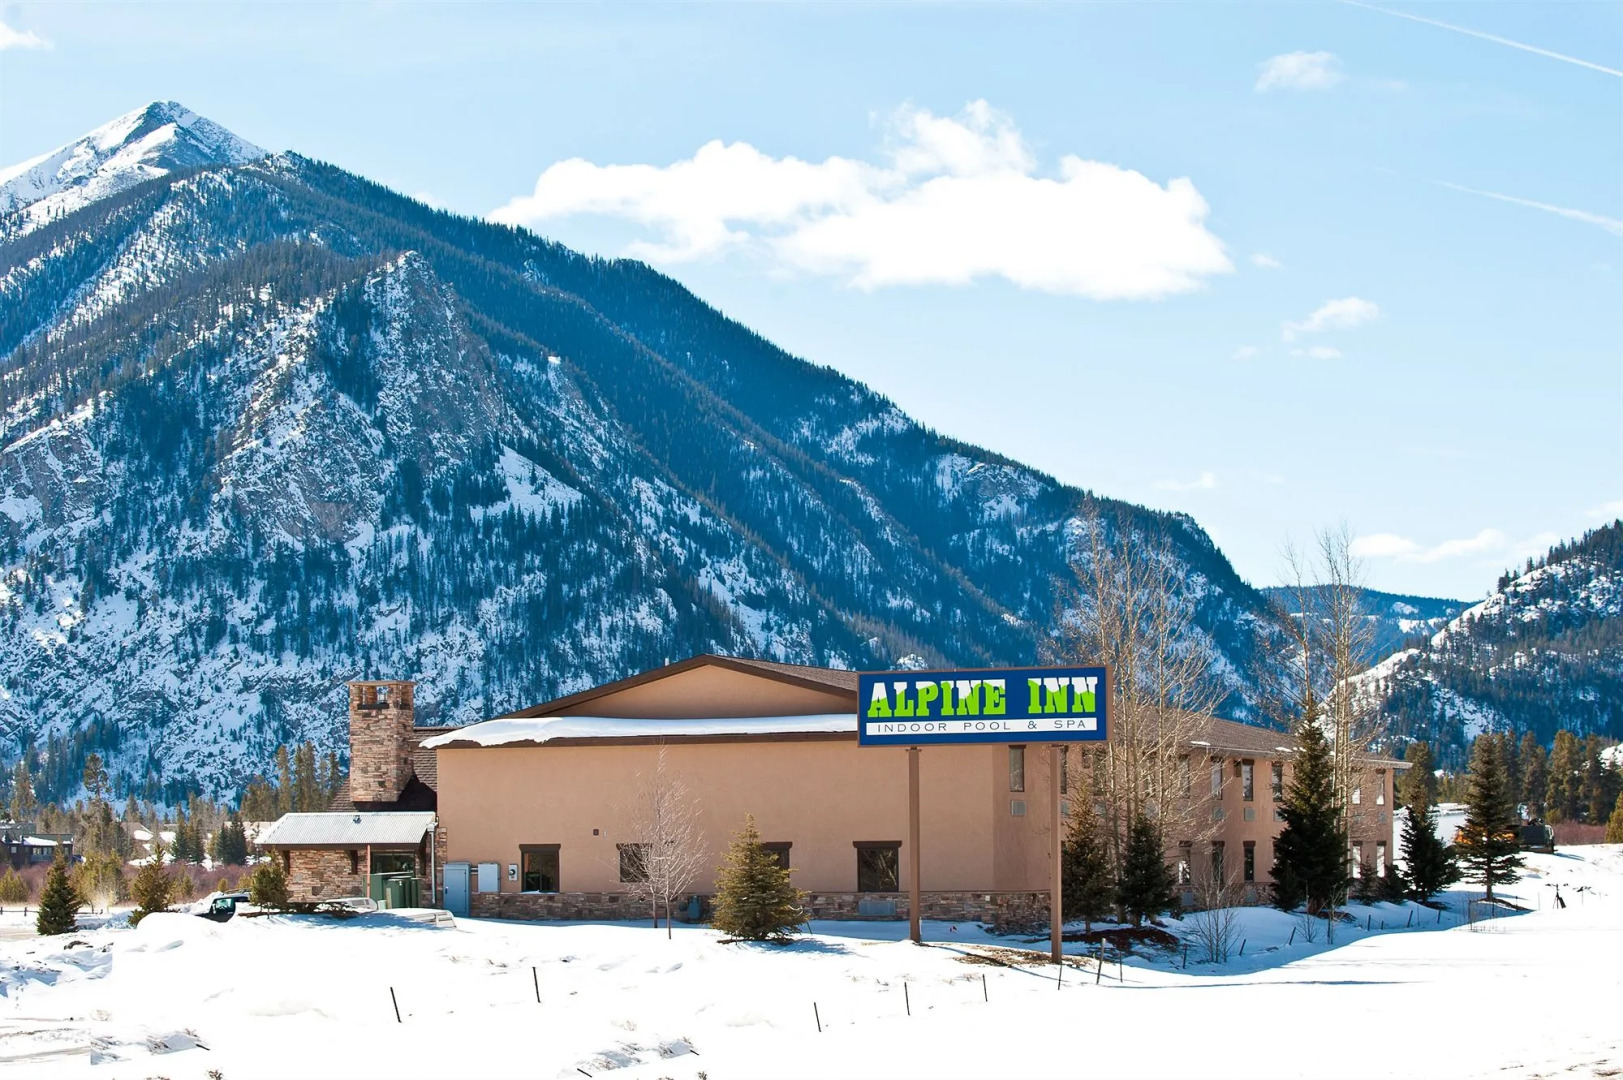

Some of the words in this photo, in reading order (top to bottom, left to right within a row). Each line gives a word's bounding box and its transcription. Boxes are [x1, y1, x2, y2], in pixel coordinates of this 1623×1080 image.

[867, 679, 1006, 718] ALPINE
[1027, 676, 1098, 714] INN
[877, 723, 947, 733] INDOOR
[963, 721, 1011, 731] POOL
[1027, 720, 1038, 730] &
[1054, 719, 1086, 729] SPA
